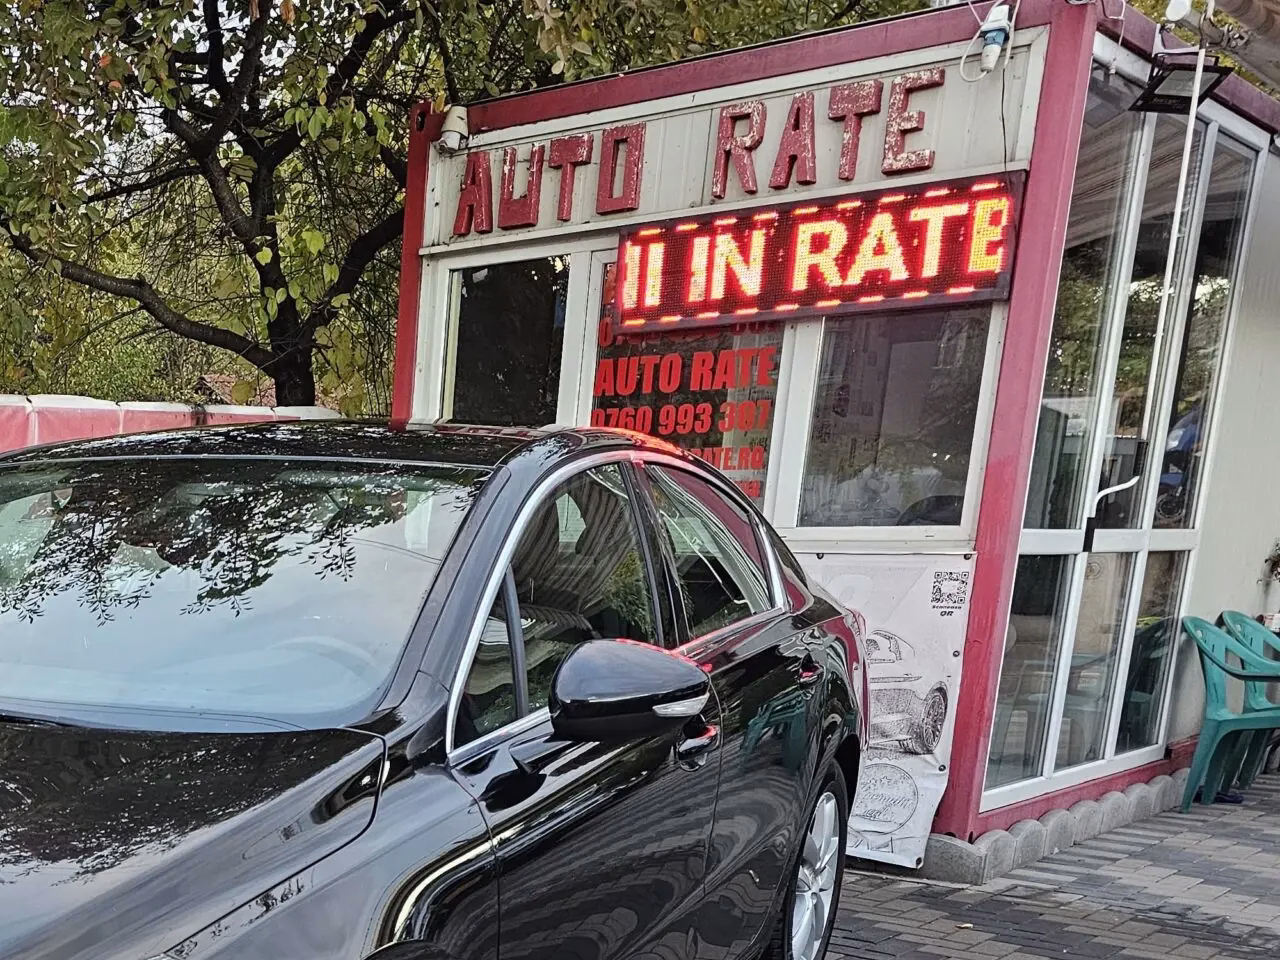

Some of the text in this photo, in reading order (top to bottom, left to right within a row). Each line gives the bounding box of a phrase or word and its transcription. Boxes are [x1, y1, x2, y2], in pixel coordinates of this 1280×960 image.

[453, 66, 946, 235] AUTO RATE
[688, 229, 766, 304] IN
[593, 345, 777, 396] AUTO RATE
[658, 403, 713, 435] 993
[718, 400, 774, 432] 307
